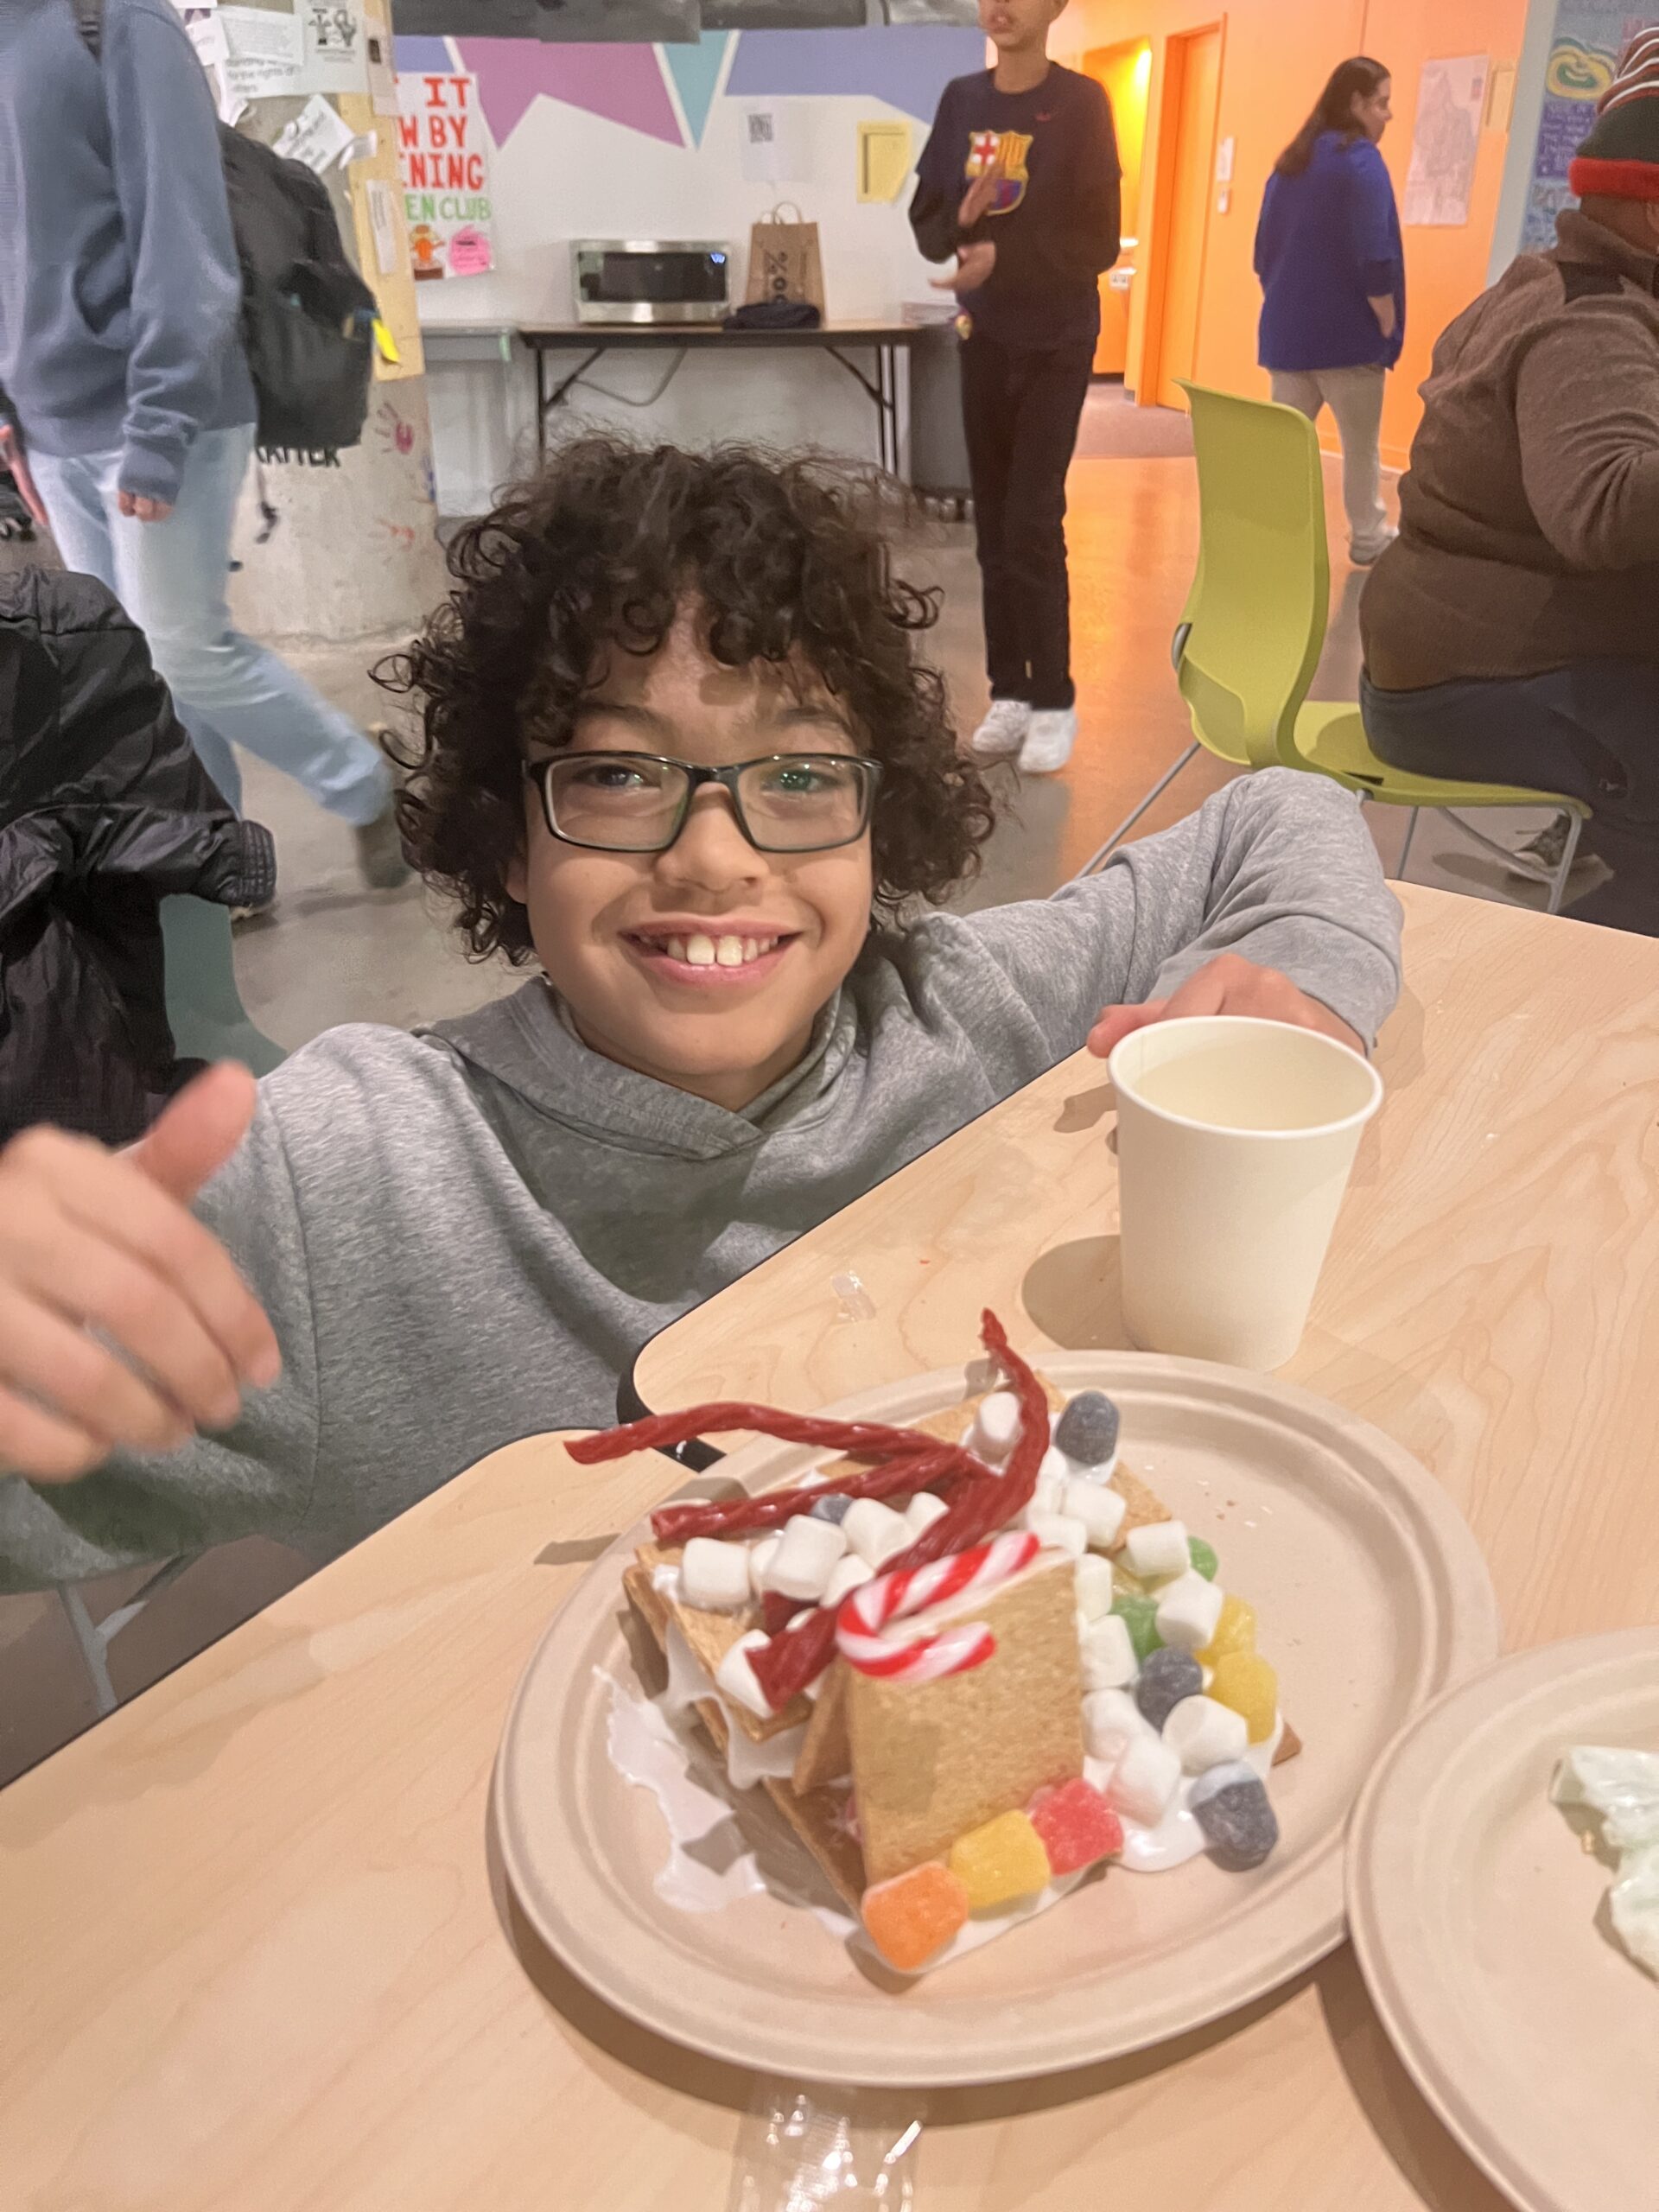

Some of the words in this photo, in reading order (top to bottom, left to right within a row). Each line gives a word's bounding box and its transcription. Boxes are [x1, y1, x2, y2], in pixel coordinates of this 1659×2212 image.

[423, 76, 471, 108] IT
[427, 114, 467, 149] BY
[398, 152, 484, 192] NING
[438, 196, 493, 221] CLUB
